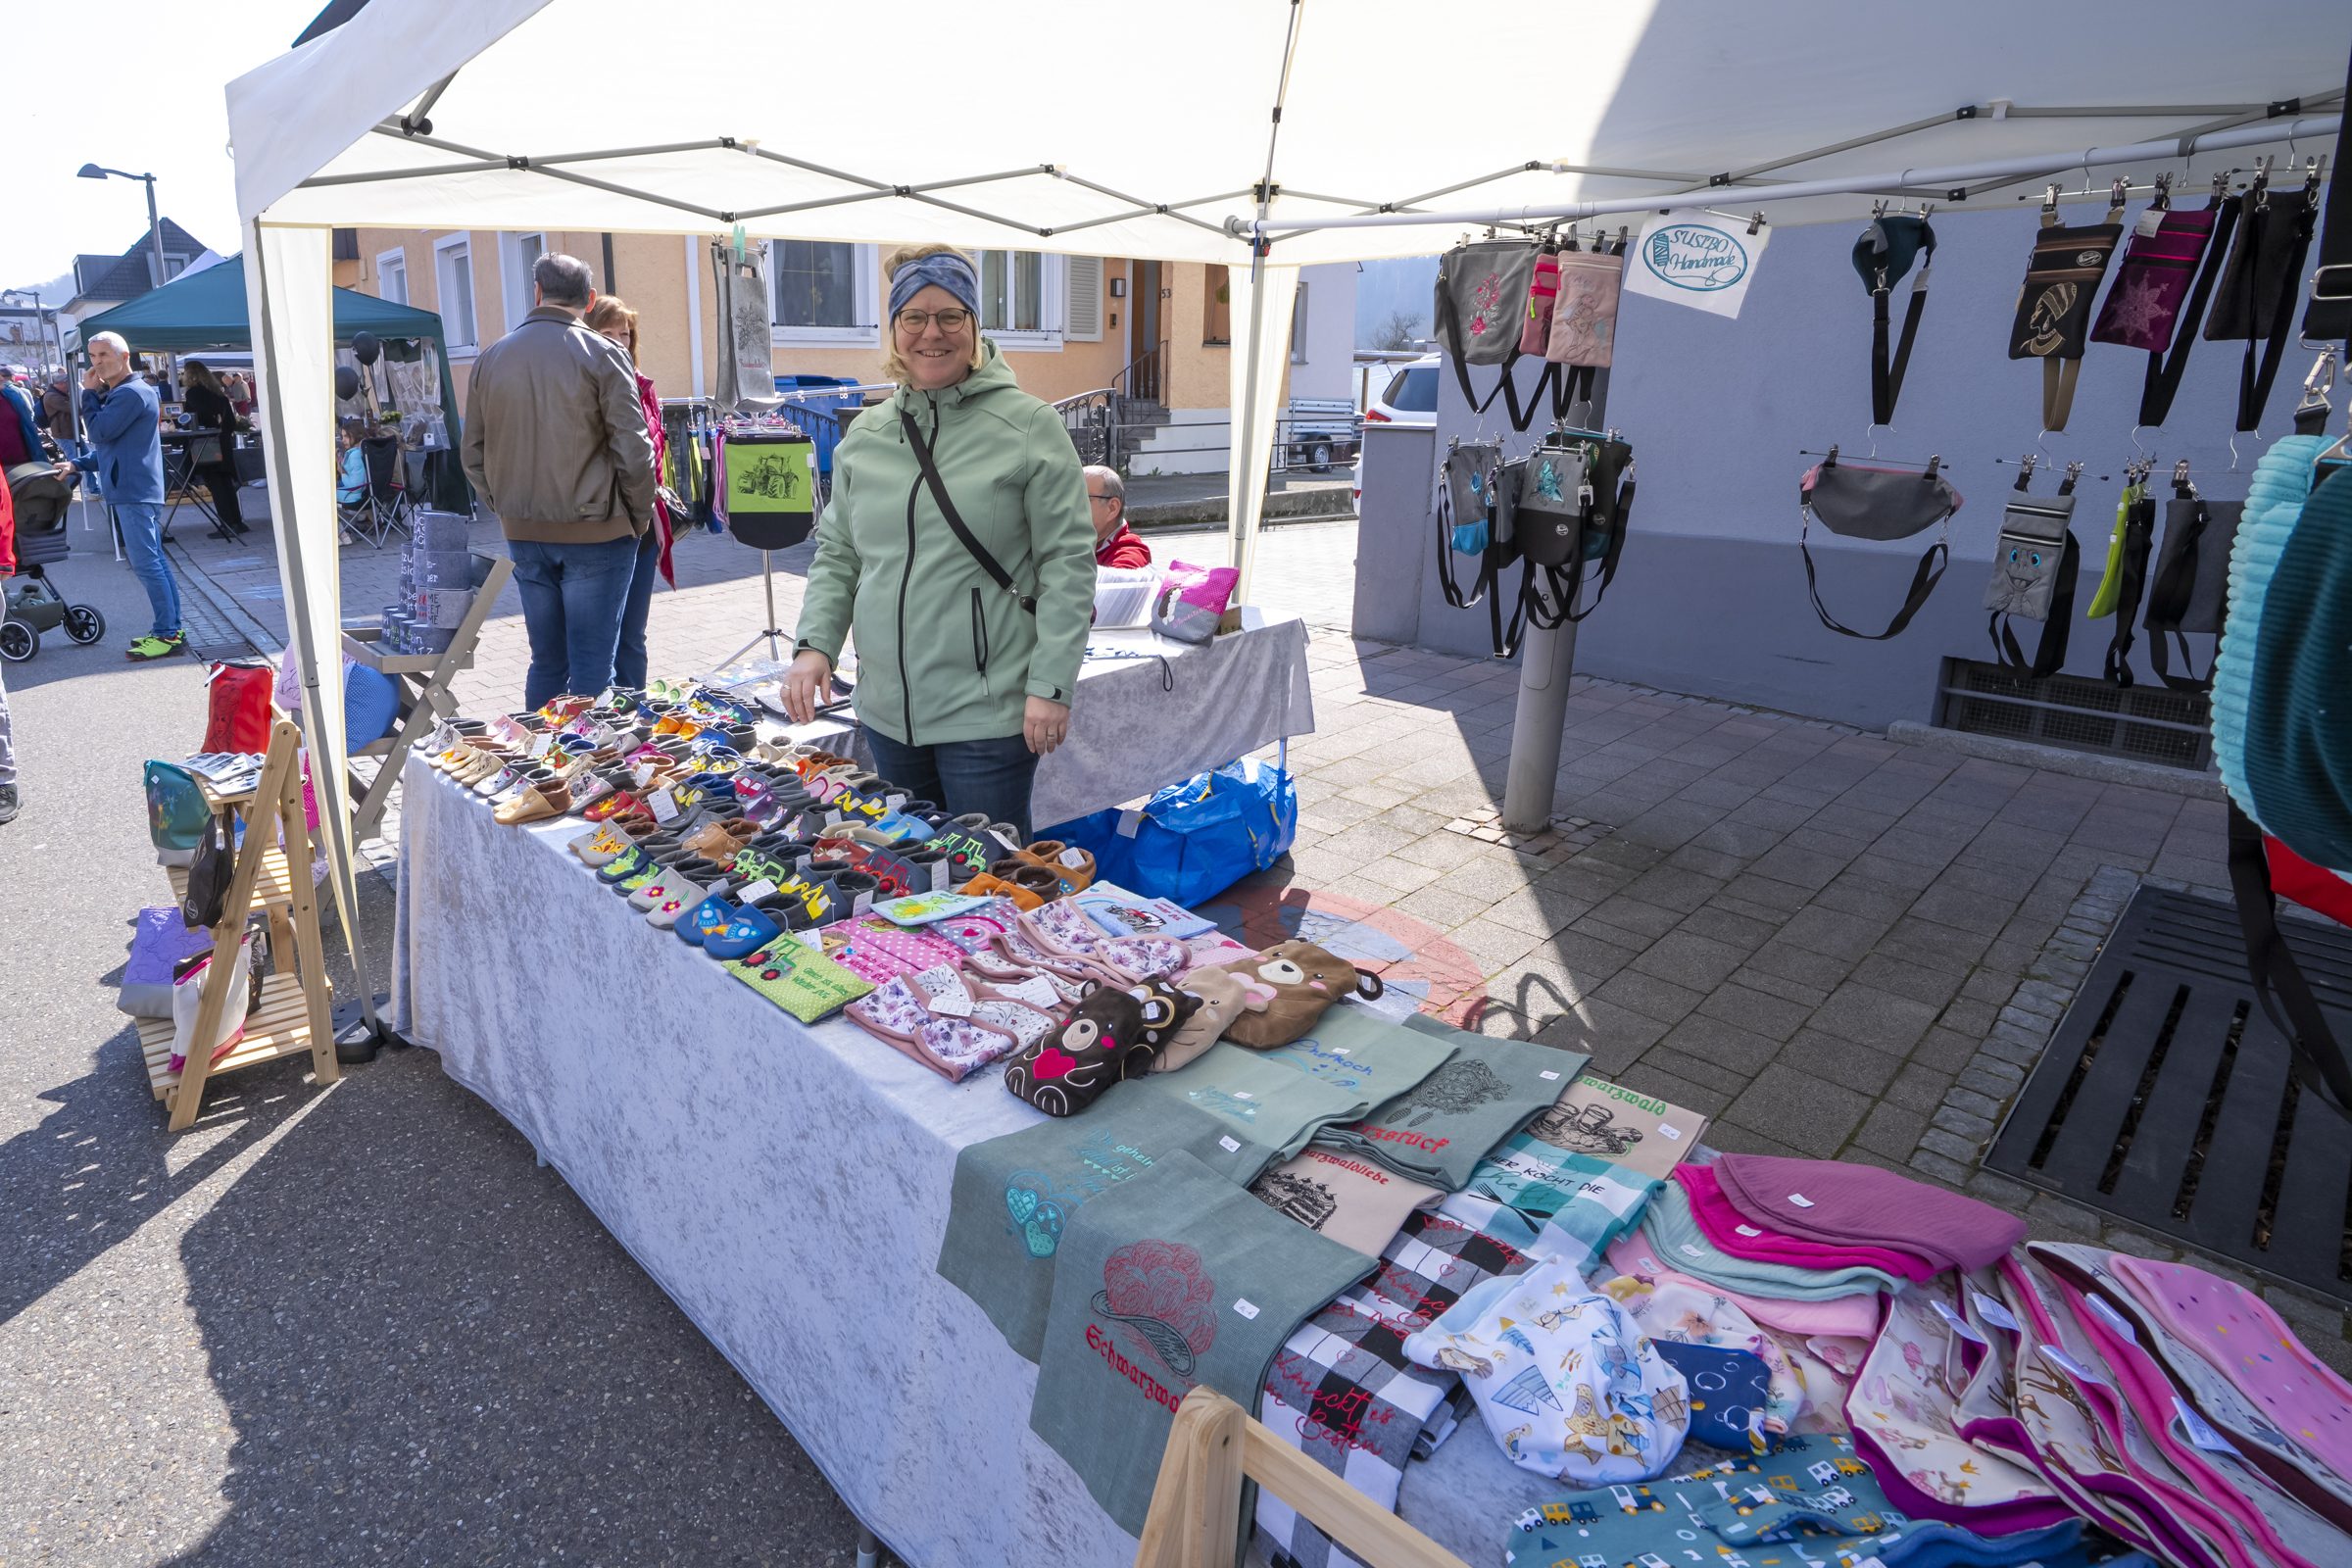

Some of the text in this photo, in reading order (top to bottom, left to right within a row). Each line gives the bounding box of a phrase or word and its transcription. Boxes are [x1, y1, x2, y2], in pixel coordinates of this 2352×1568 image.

[1669, 244, 1736, 270] Handmade
[1161, 288, 1172, 299] 53
[1288, 1039, 1372, 1076] Chefkoch
[1574, 1074, 1666, 1116] warzwald
[1351, 1121, 1449, 1153] erzstück
[1110, 1162, 1131, 1175] ist
[1489, 1154, 1606, 1195] HIER KOCHT DIE
[1422, 1215, 1465, 1232] Bei
[1365, 1310, 1411, 1342] Ma
[1086, 1324, 1188, 1414] Schwarzwa
[1295, 1407, 1384, 1456] Besten
[1369, 1408, 1396, 1425] es
